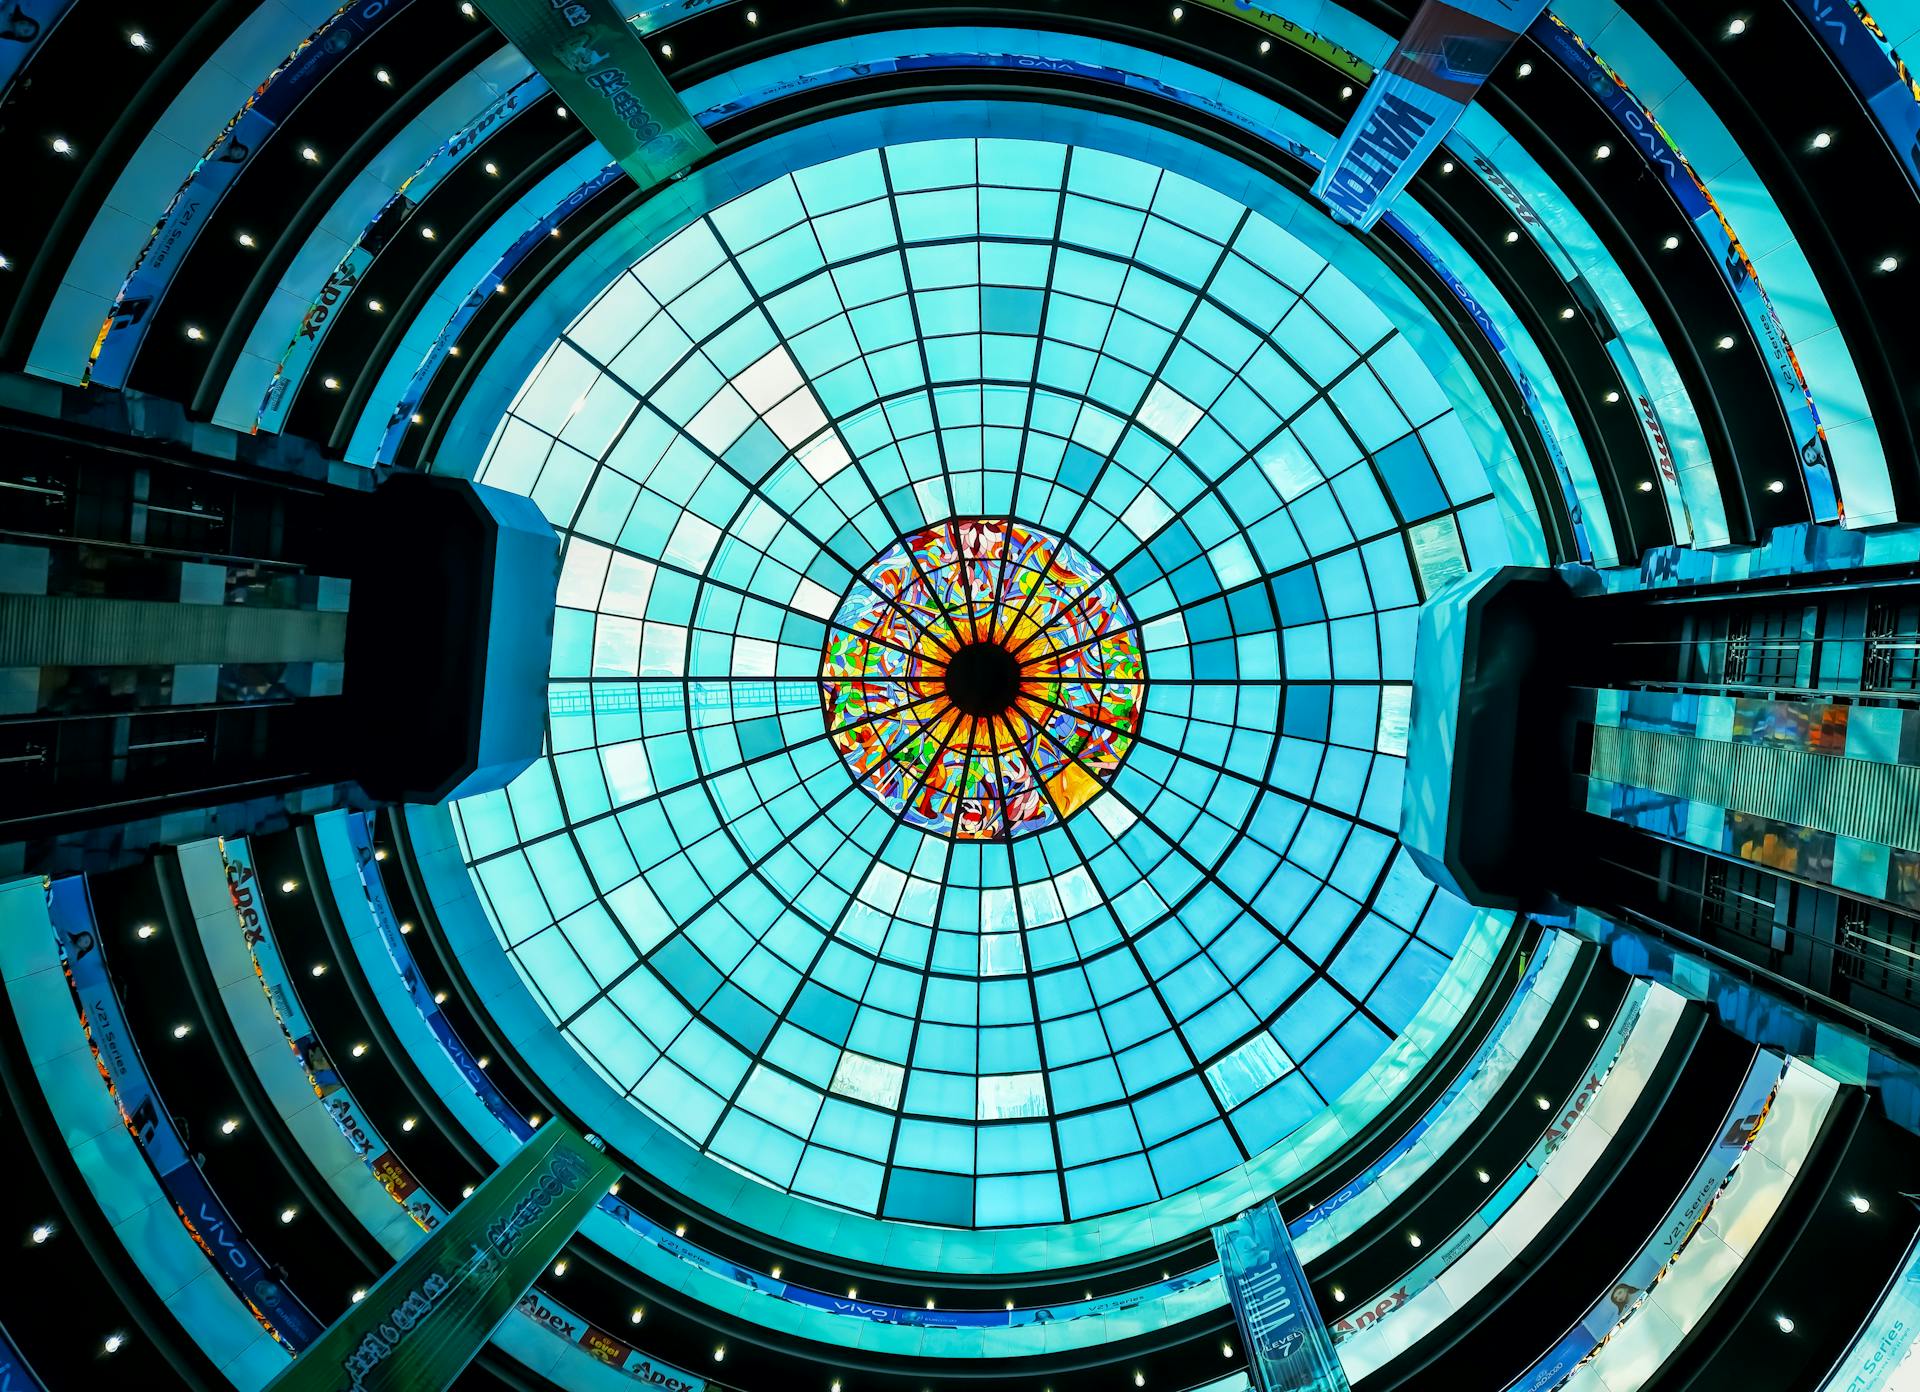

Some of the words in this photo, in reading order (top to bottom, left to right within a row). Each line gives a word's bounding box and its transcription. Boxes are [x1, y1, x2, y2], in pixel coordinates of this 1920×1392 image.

[1017, 58, 1074, 72] vivo
[1323, 91, 1436, 221] WALTON
[1621, 109, 1680, 178] vivo
[568, 168, 616, 206] vivo
[178, 199, 199, 227] V21
[152, 227, 181, 271] Series
[298, 260, 362, 343] Apex
[1452, 282, 1491, 330] vivo
[1756, 313, 1784, 360] Series
[1779, 362, 1796, 392] V21
[226, 857, 267, 946] Apex
[92, 1000, 110, 1030] V21
[104, 1031, 129, 1075] Series
[330, 1095, 375, 1154] Apex
[1304, 1188, 1353, 1225] vivo
[1662, 1220, 1686, 1247] V21
[1682, 1175, 1717, 1218] Series
[195, 1201, 250, 1269] vivo
[520, 1291, 576, 1336] Apex
[833, 1299, 888, 1318] vivo
[1088, 1303, 1110, 1312] V21
[1111, 1294, 1144, 1307] Series
[1239, 1262, 1296, 1339] VOGUE
[1265, 1332, 1300, 1351] LEVEL
[1279, 1342, 1291, 1357] 7
[1862, 1318, 1904, 1373] Series
[630, 1358, 693, 1392] Apex
